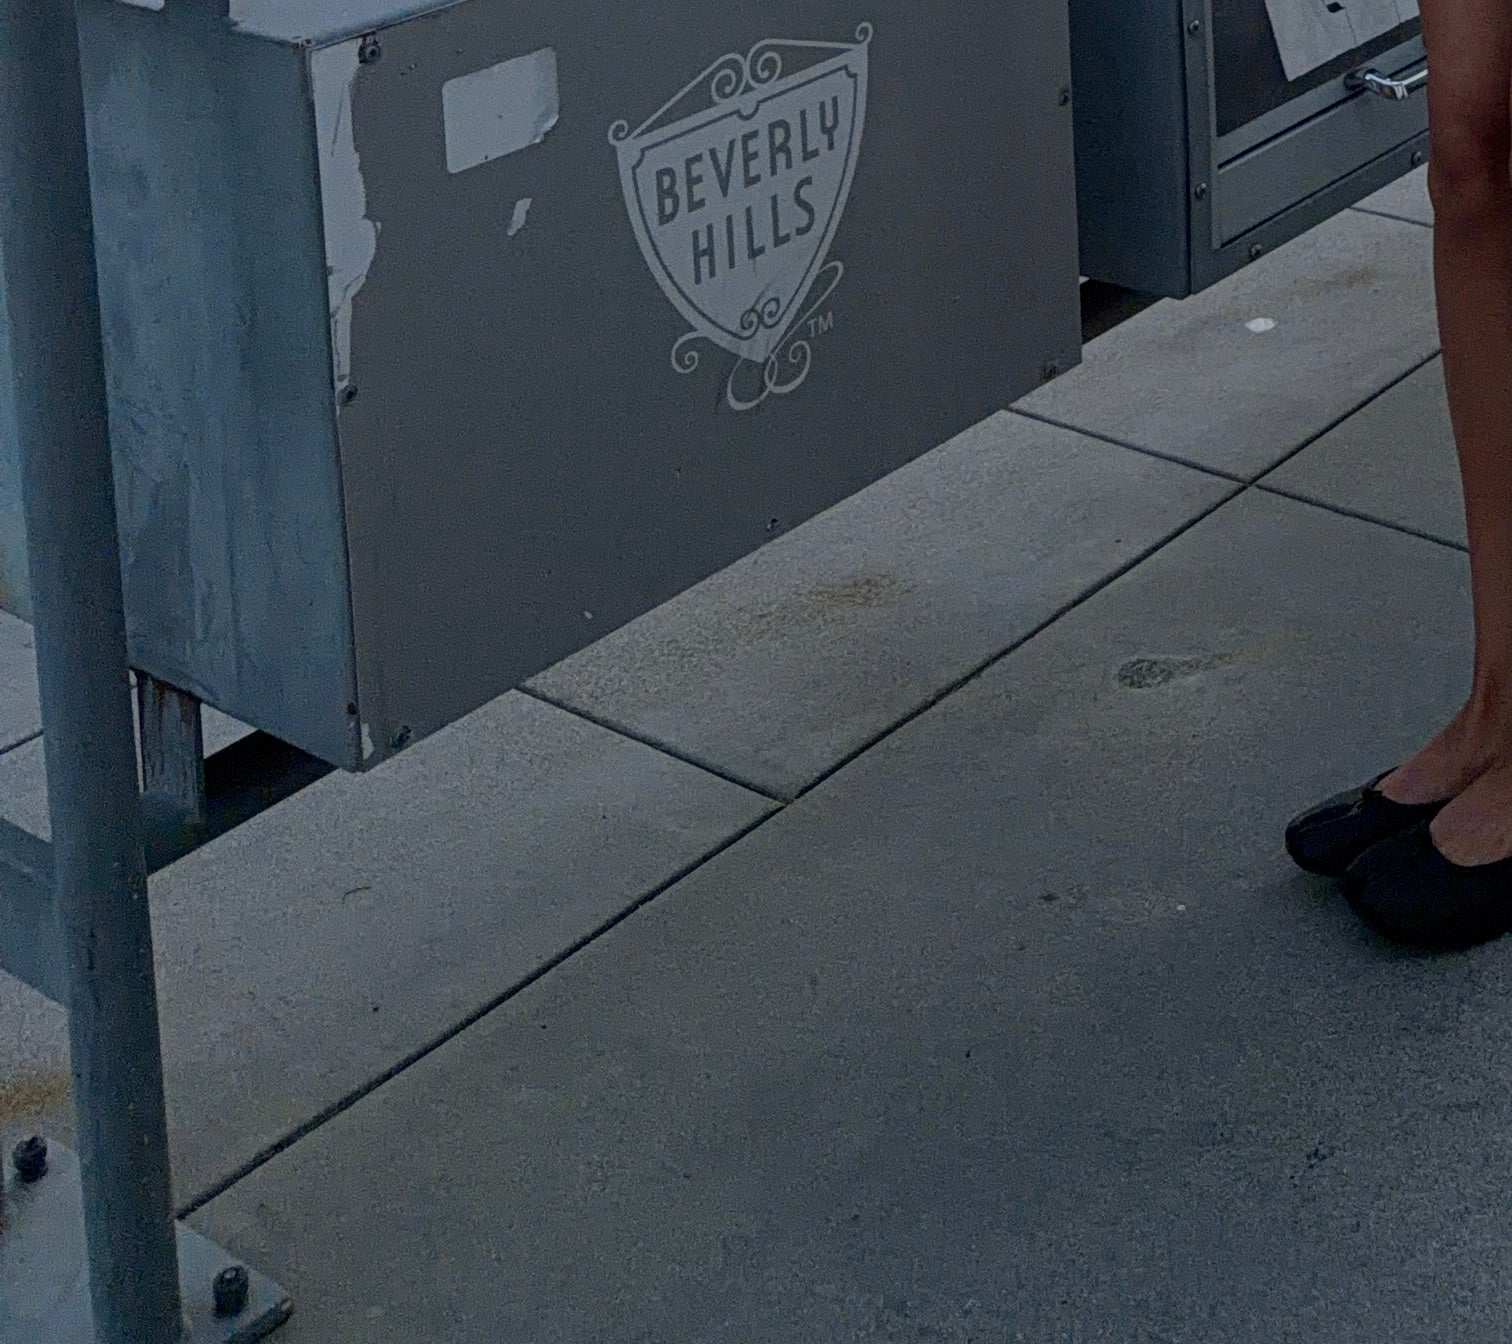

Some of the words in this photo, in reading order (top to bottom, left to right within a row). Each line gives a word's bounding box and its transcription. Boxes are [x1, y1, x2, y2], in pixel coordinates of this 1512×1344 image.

[655, 95, 839, 226] BEVERLY
[692, 176, 816, 285] HILLS
[807, 311, 834, 338] TM
